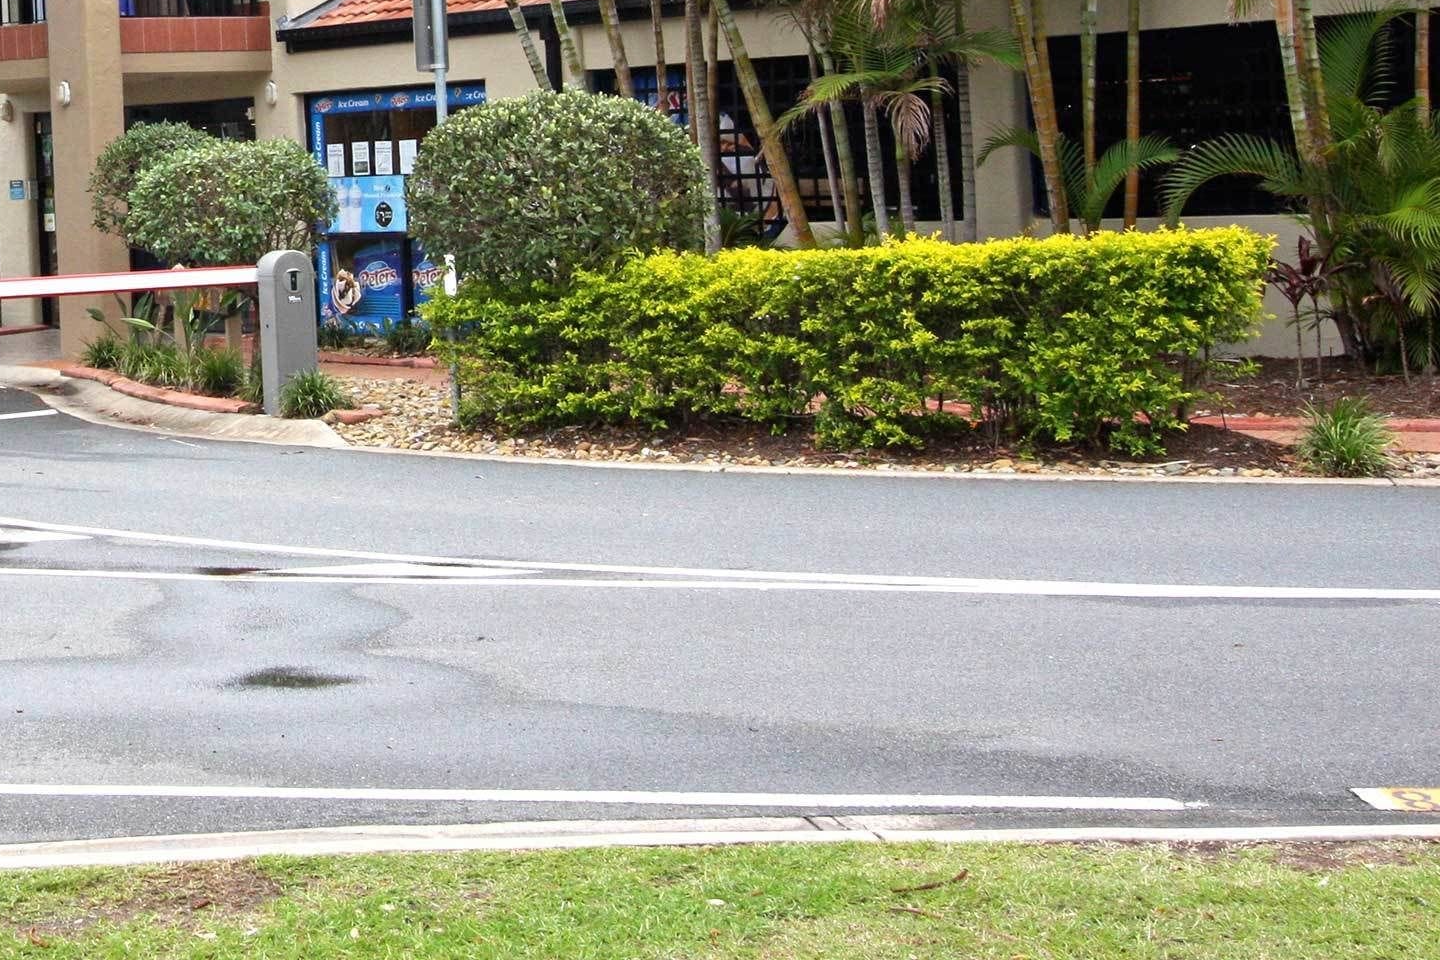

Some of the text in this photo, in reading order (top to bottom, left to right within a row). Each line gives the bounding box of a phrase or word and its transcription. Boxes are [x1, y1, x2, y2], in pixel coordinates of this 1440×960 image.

[415, 94, 425, 102] Ice
[425, 93, 436, 101] Cre
[473, 90, 485, 99] Cre
[338, 100, 348, 108] Ice
[359, 267, 398, 289] Peters
[411, 267, 445, 289] Peter
